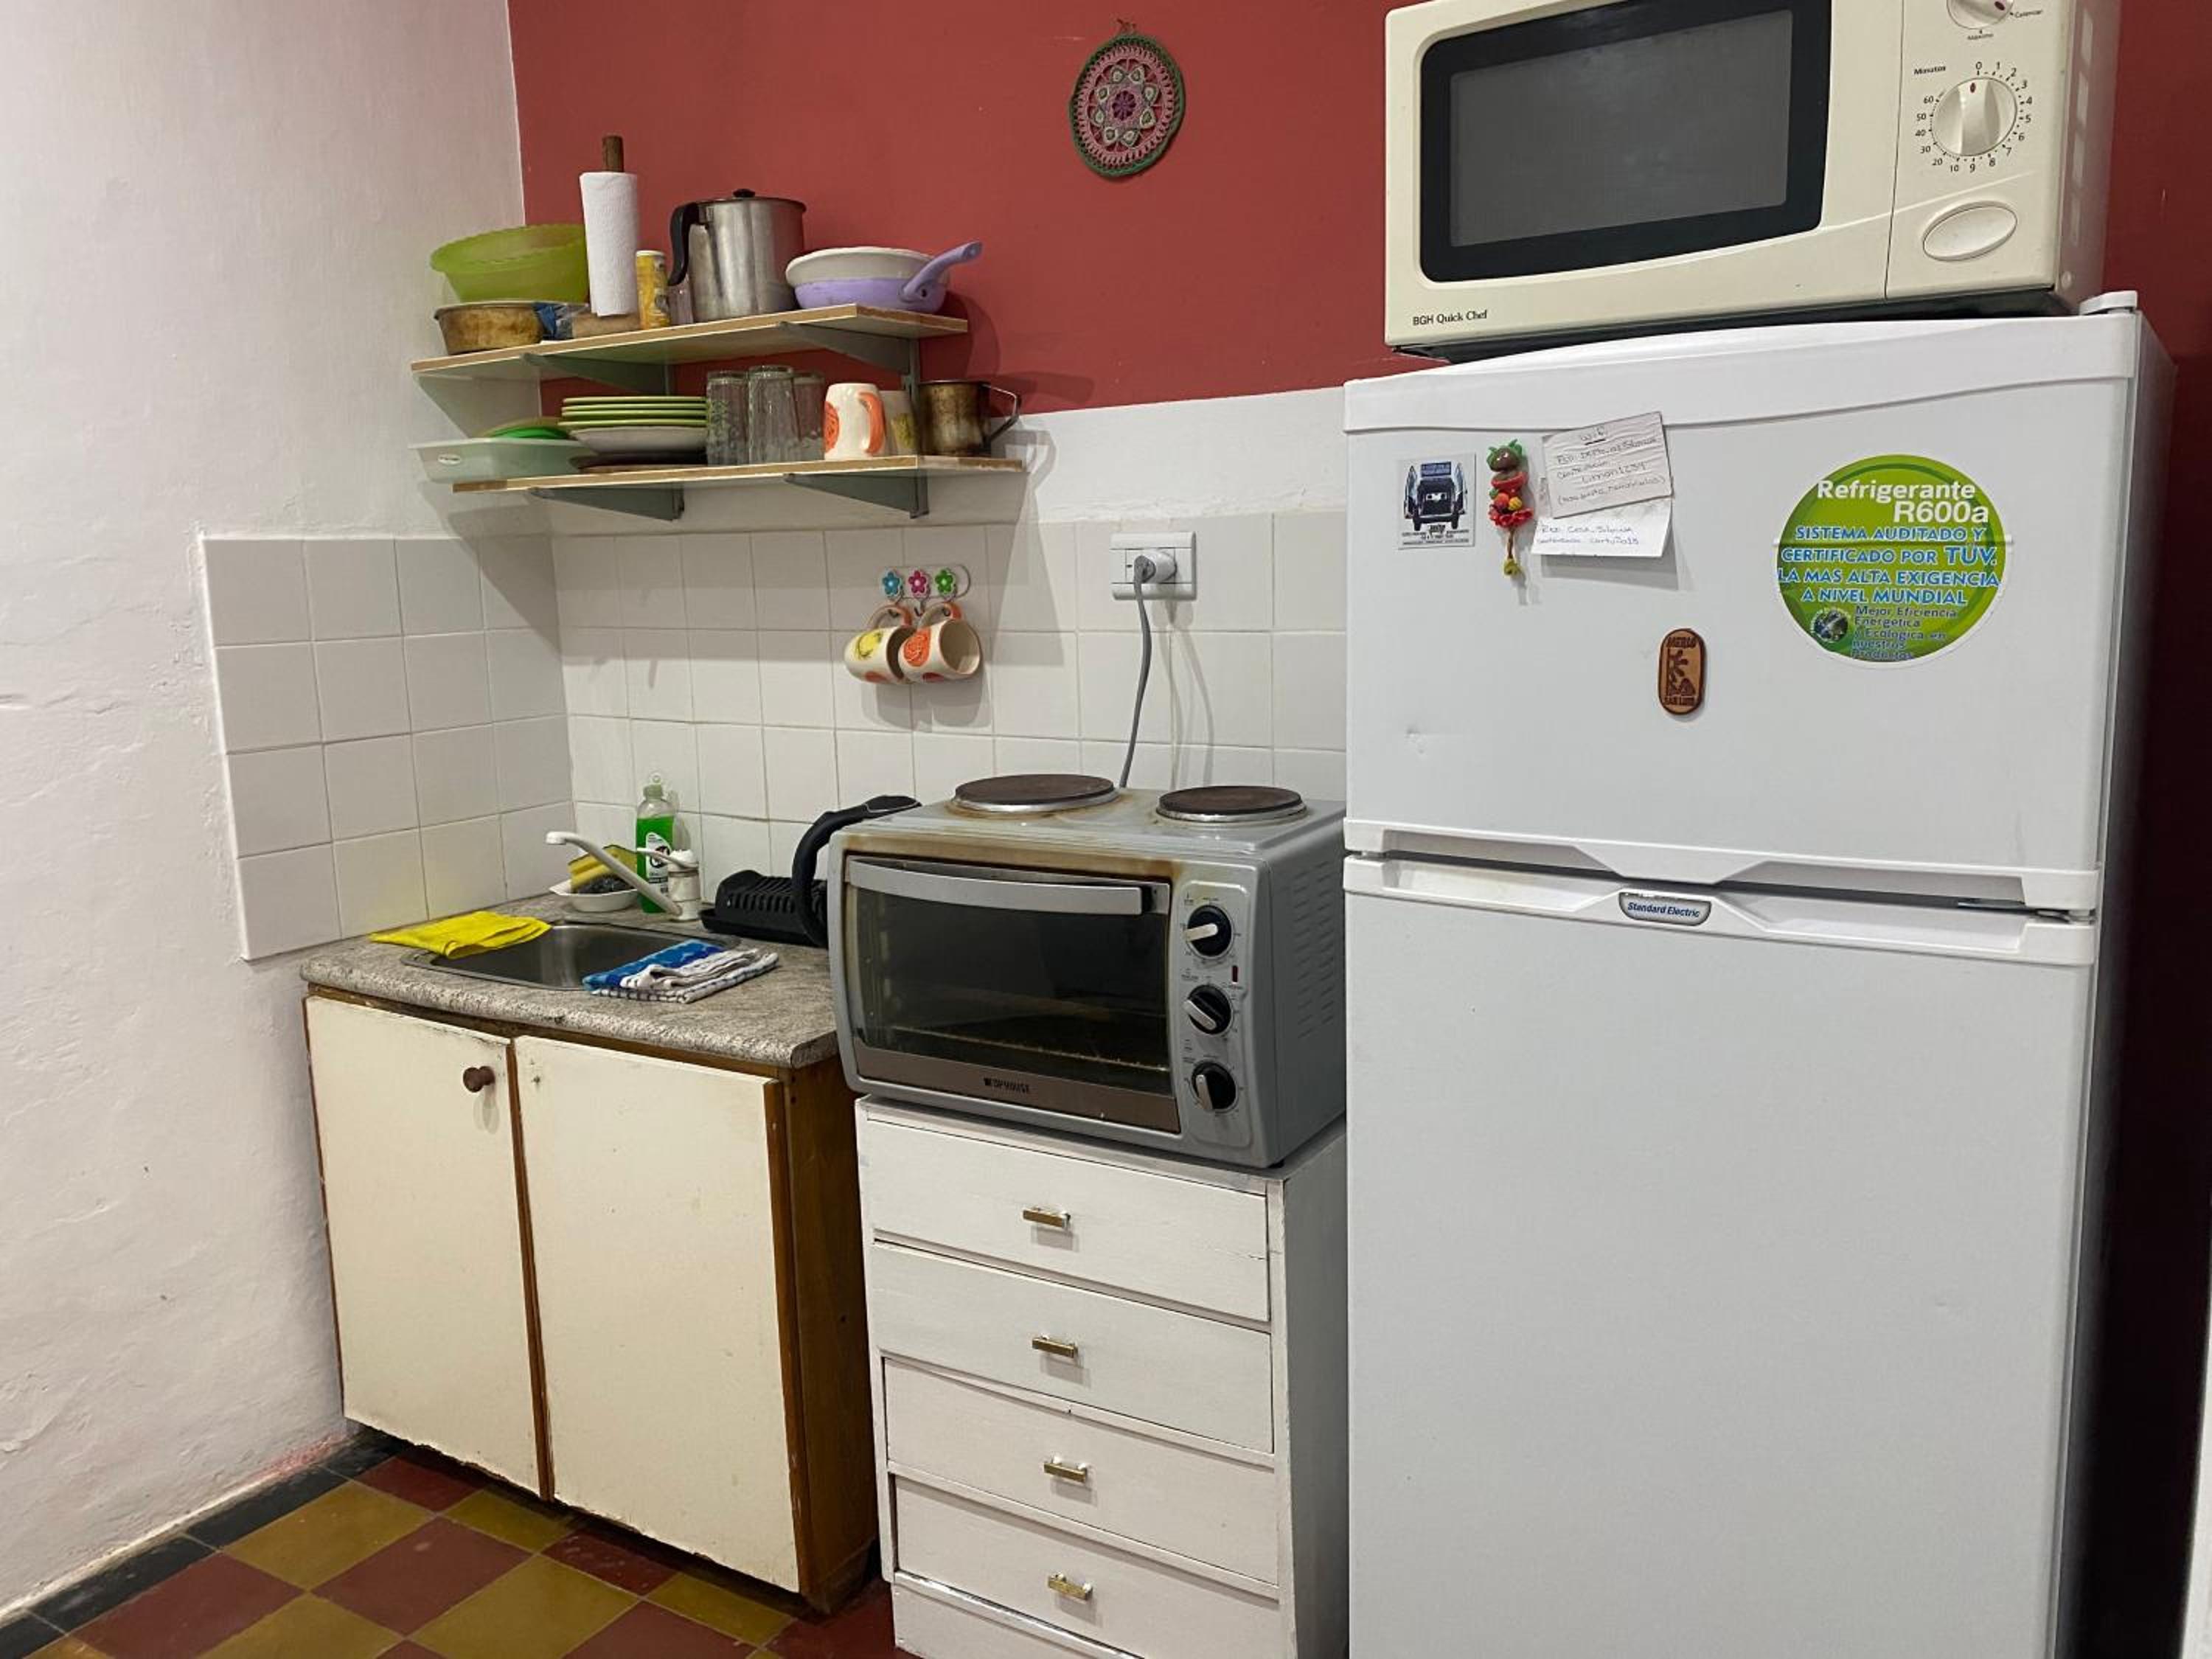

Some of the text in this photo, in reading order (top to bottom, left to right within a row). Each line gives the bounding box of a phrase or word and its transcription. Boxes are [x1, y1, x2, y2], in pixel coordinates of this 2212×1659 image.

[1914, 64, 1947, 75] Minutos
[1975, 61, 1983, 70] 0
[1995, 61, 2001, 69] 1
[2011, 67, 2017, 77] 2
[2021, 80, 2028, 88] 3
[1923, 95, 1934, 104] 60
[2025, 97, 2033, 105] 4
[1916, 113, 1927, 121] 50
[2025, 114, 2032, 123] 5
[1915, 129, 1926, 137] 40
[2018, 133, 2025, 141] 6
[1920, 145, 1931, 153] 30
[2006, 147, 2012, 156] 7
[1932, 158, 1943, 166] 20
[1989, 158, 1996, 167] 8
[1950, 164, 1959, 173] 10
[1969, 164, 1976, 173] 9
[1412, 309, 1488, 326] BGH Quick Chef
[1817, 480, 1975, 503] Refrigerante
[1893, 501, 1989, 524] R600a
[1795, 527, 1986, 541] SISTEMA AUDITADO Y
[1781, 548, 1895, 564] CERTIFICADO
[1902, 549, 1937, 565] POR
[1778, 568, 2000, 587] LA MAS ALTA EXIGENCIA
[1801, 588, 1968, 607] A NIVEL MUNDIAL
[1855, 605, 1957, 618] Mejor Eficiencia
[1627, 902, 1700, 918] Standard Electric
